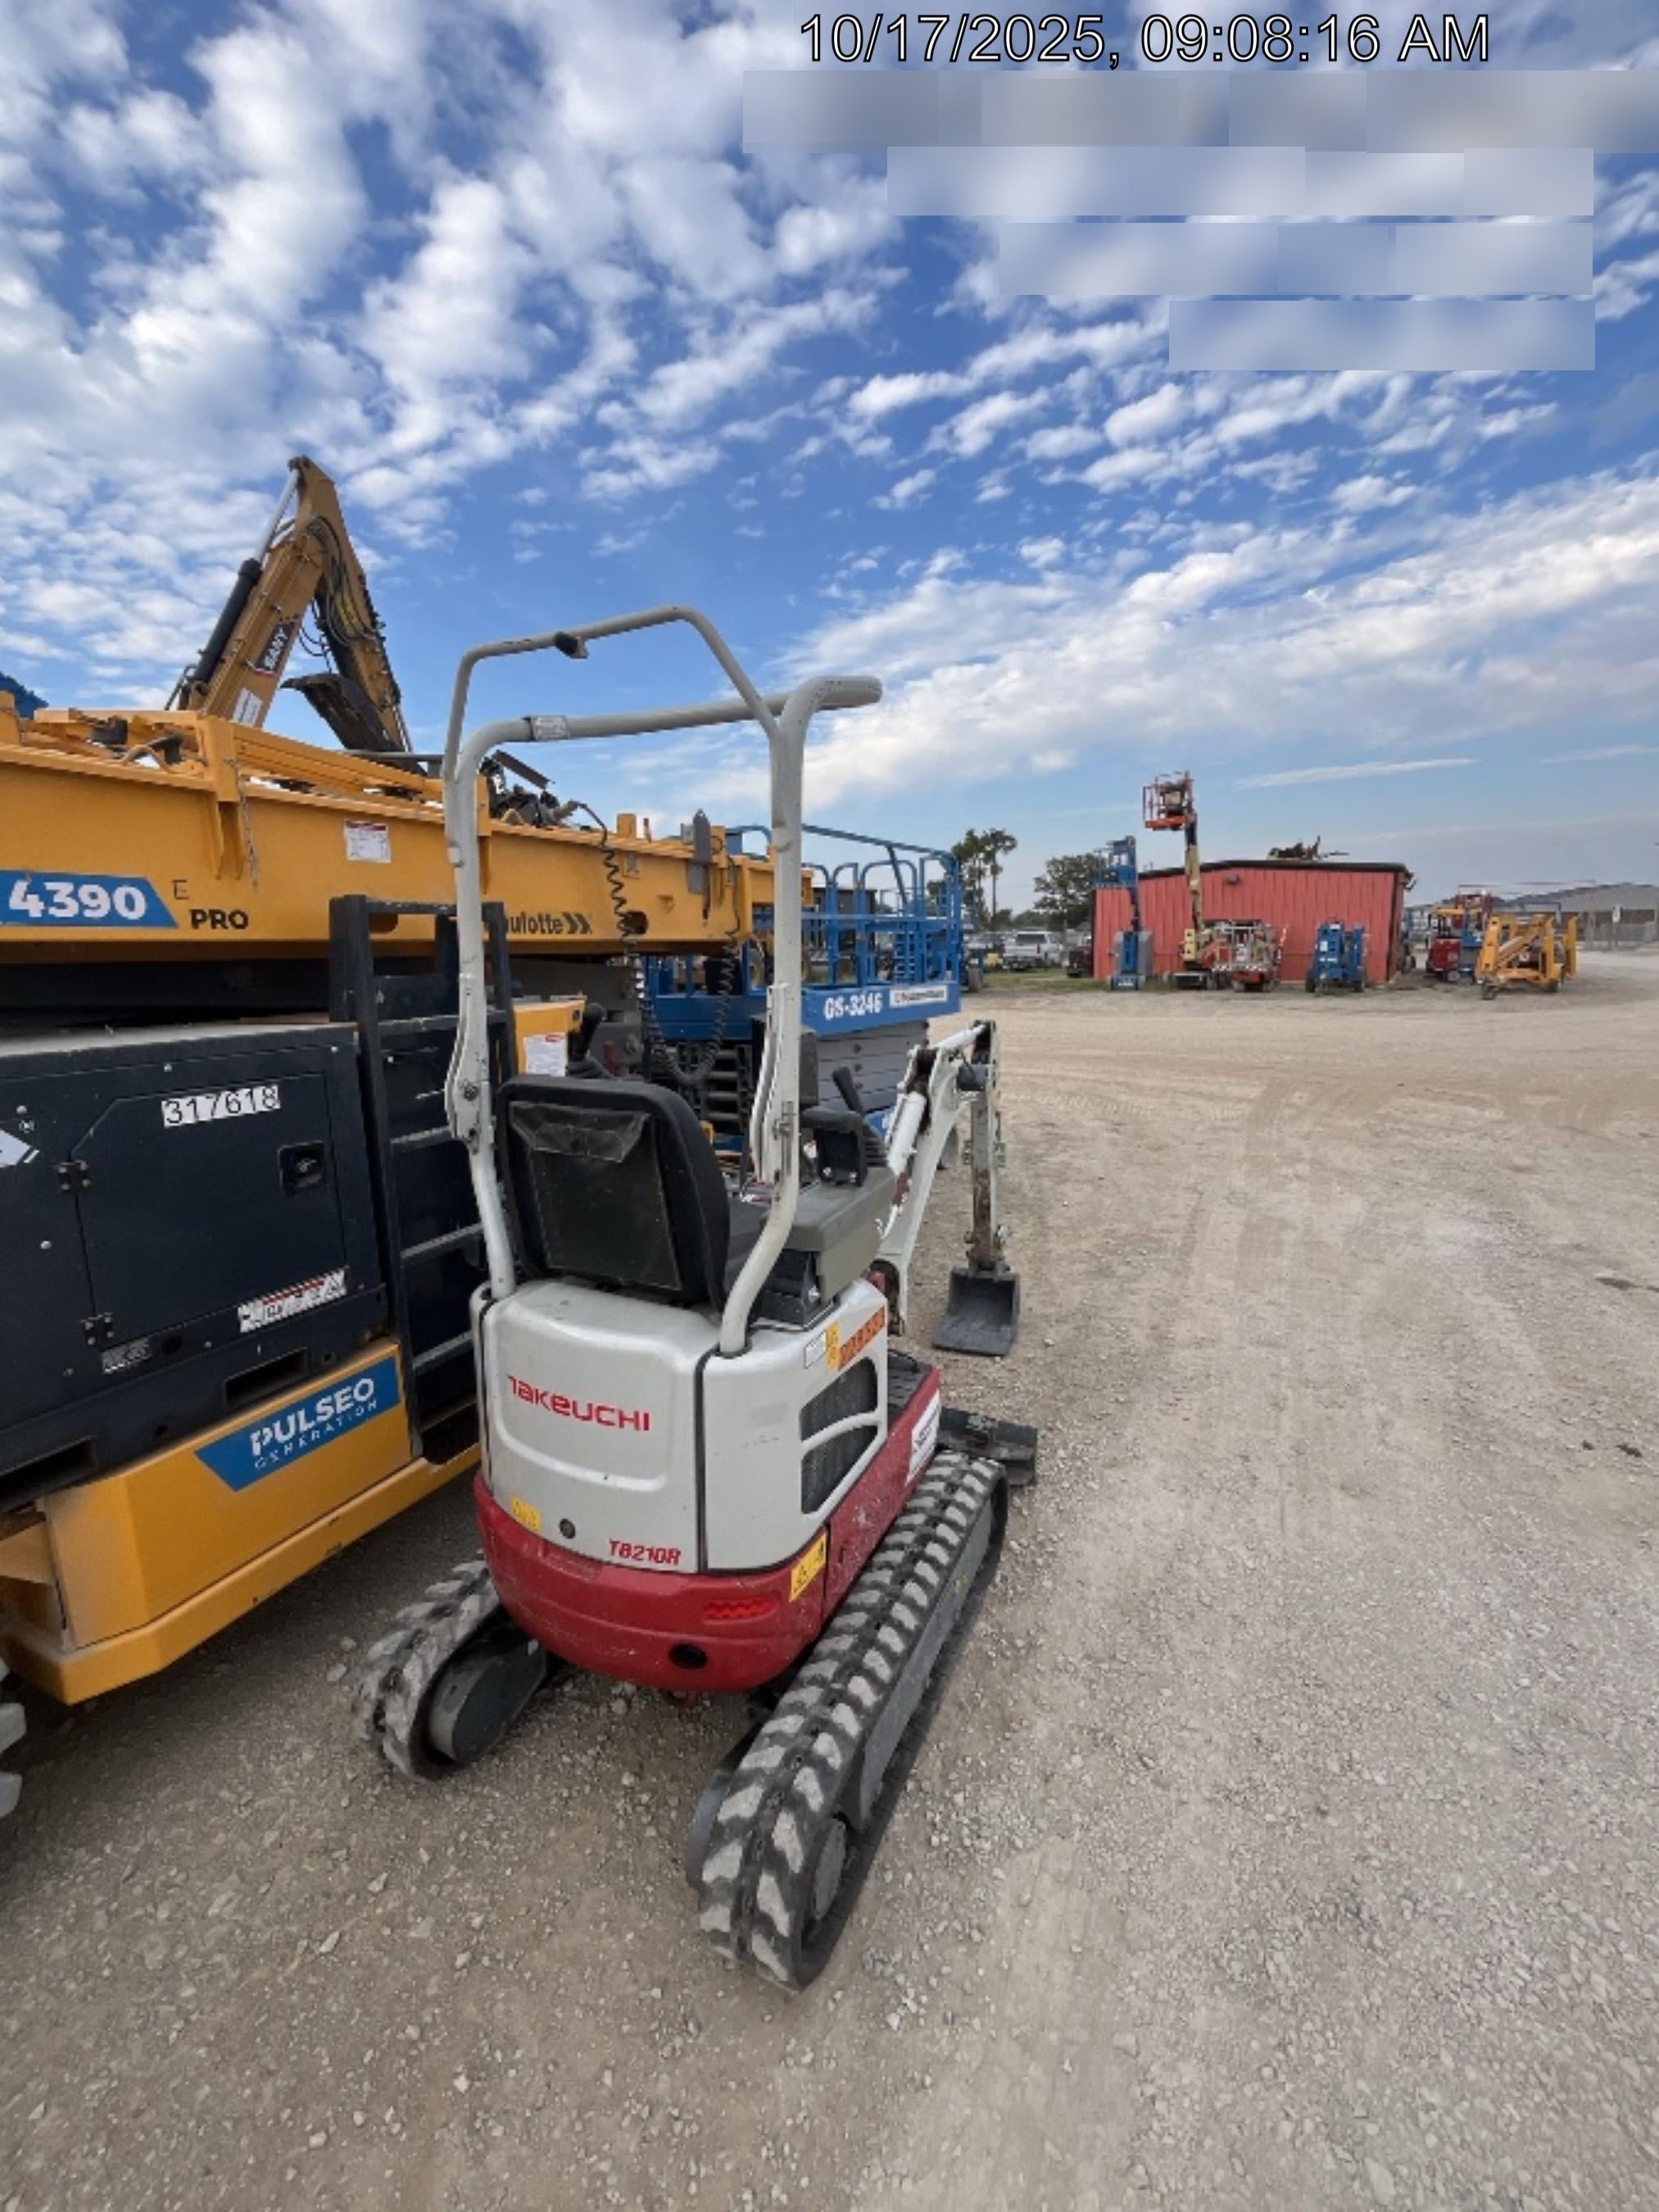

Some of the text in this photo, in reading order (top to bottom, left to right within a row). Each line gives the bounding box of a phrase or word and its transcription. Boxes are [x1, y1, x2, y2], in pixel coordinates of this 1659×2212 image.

[264, 627, 288, 669] SANY
[9, 879, 147, 919] 4390
[189, 909, 249, 929] PRO
[166, 1088, 275, 1123] 317618
[250, 1378, 374, 1456] PULSEO
